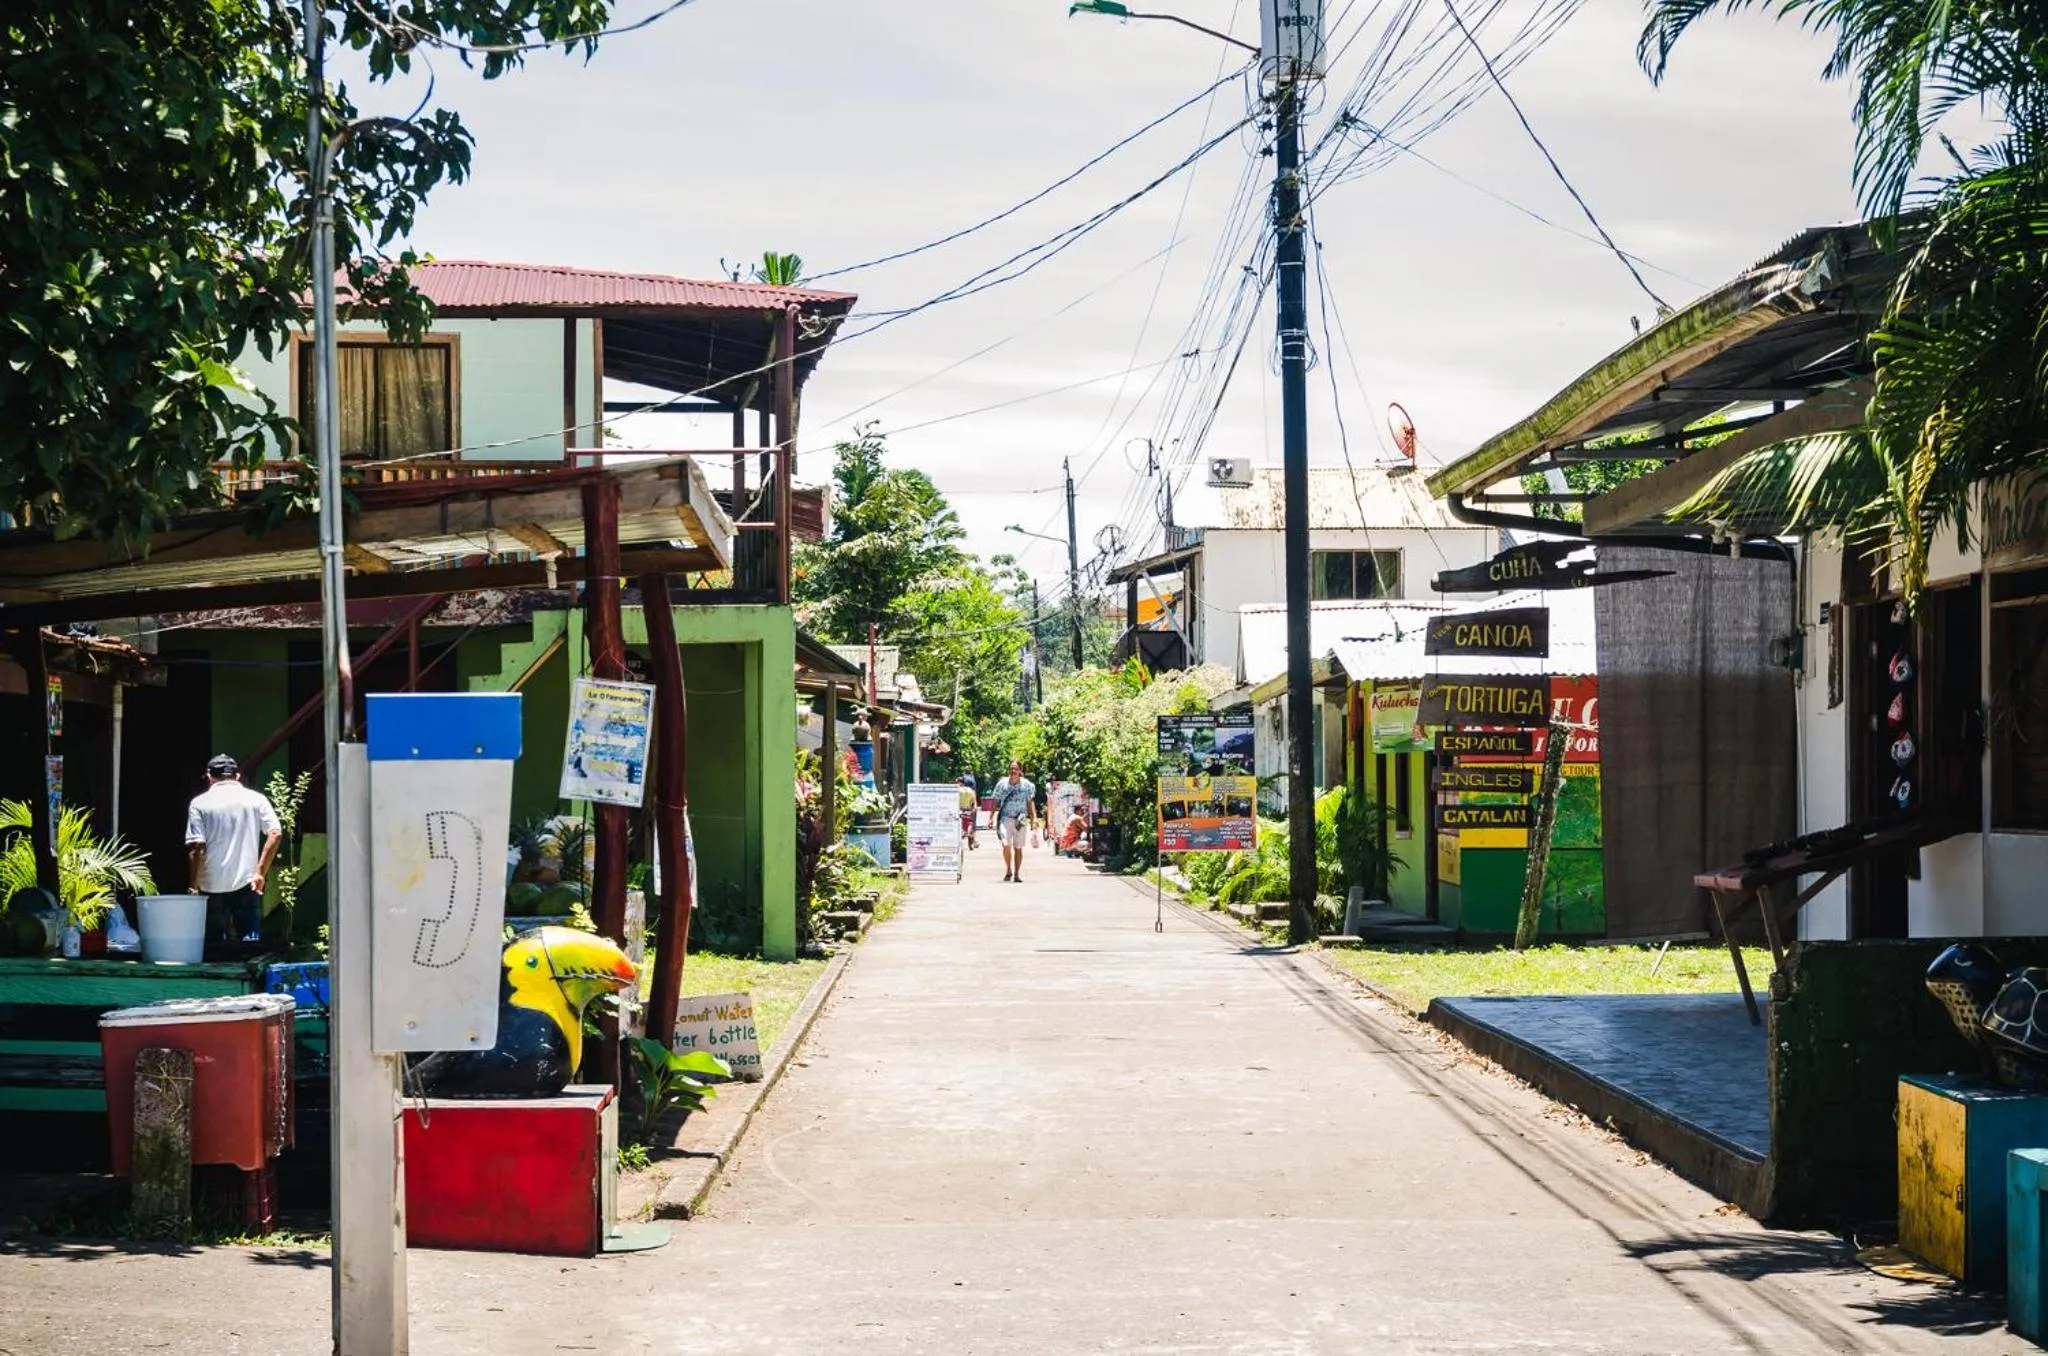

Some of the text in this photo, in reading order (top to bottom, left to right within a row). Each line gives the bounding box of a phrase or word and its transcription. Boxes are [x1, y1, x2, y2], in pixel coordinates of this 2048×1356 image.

[1455, 624, 1532, 647] CANOA
[1440, 684, 1544, 716] TORTUGA
[1442, 736, 1524, 751] ESPAÑOL
[1441, 772, 1522, 787] INGLES
[1443, 809, 1526, 823] CATALAN
[675, 1001, 753, 1025] onut Water
[674, 1025, 757, 1047] ter bottle
